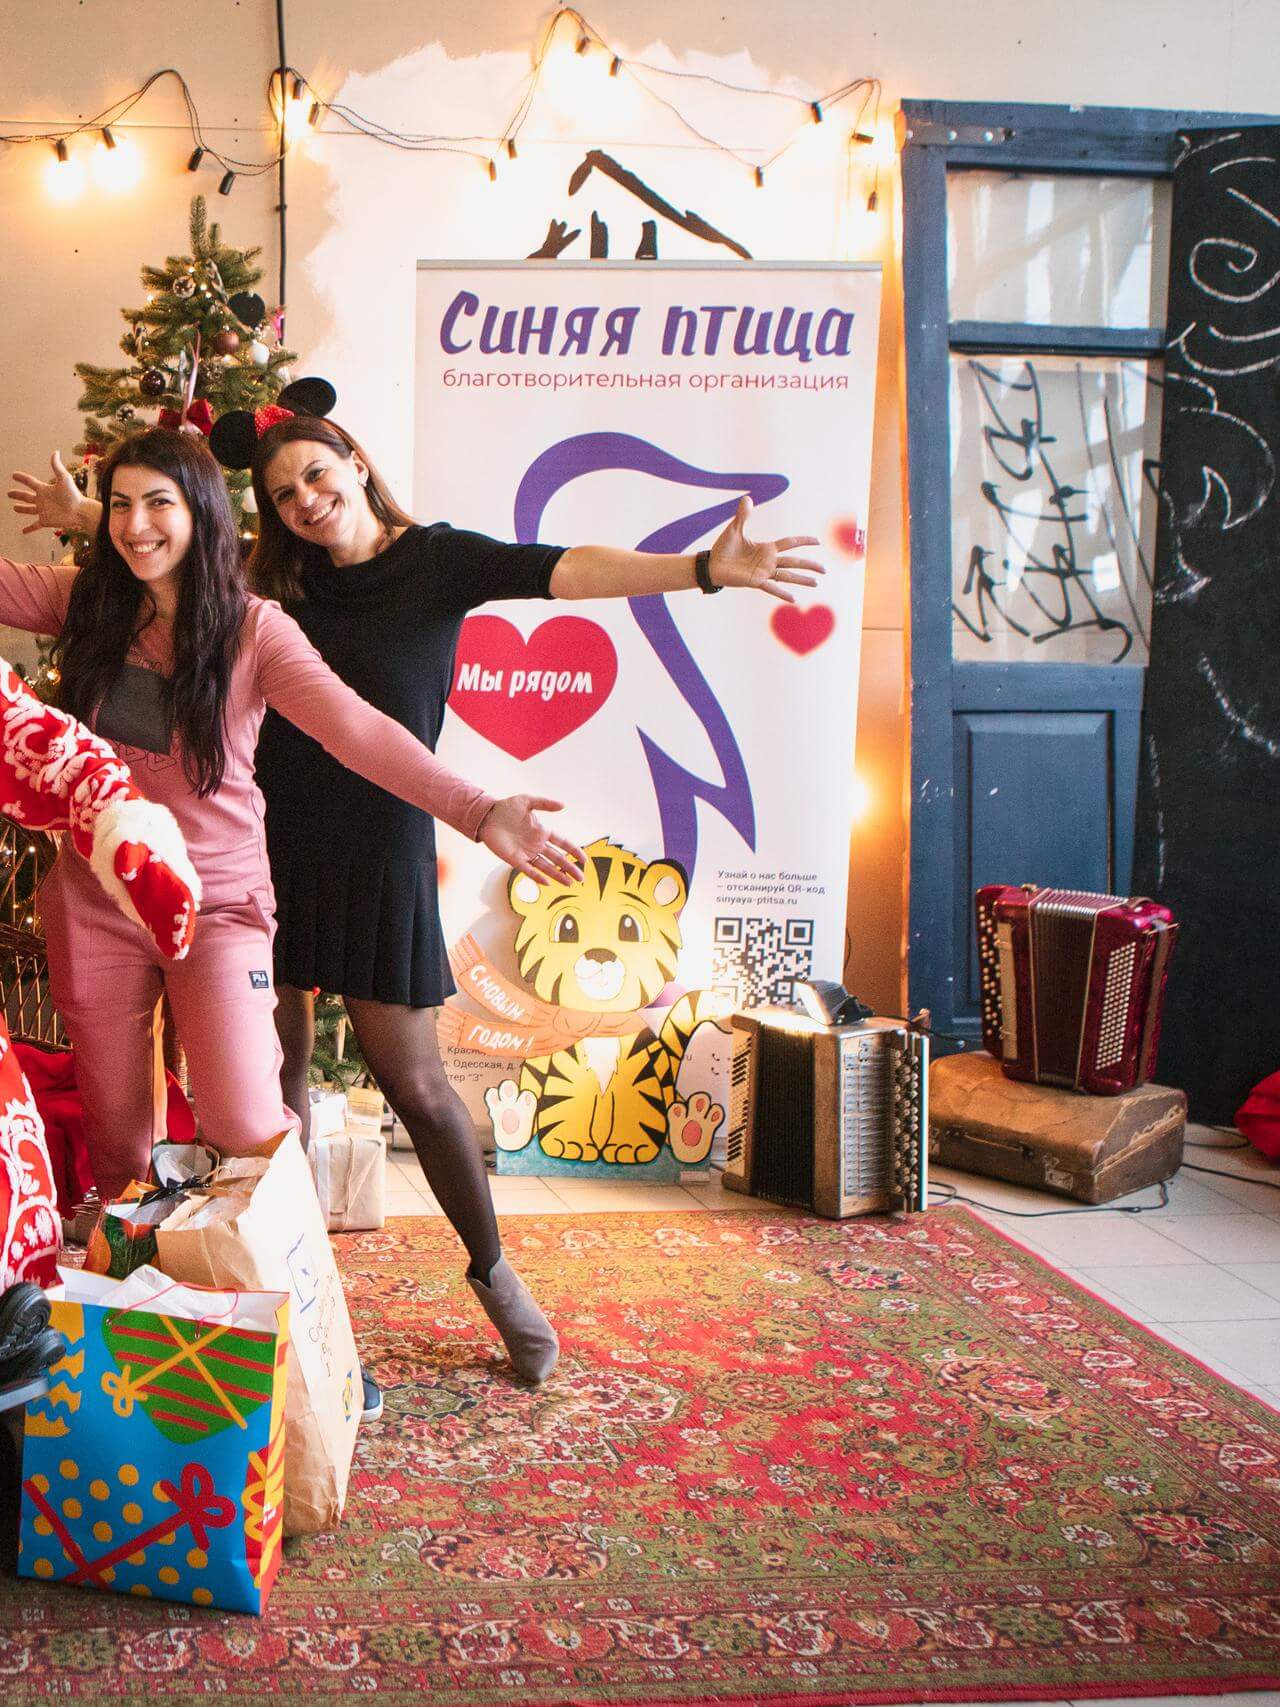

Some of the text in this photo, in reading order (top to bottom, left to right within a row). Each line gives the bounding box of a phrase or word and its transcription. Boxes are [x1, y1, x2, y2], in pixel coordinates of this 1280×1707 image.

[440, 290, 855, 362] Синяя птица
[442, 368, 849, 393] благотворительная организация
[457, 663, 593, 701] Мы рядом
[717, 870, 818, 882] Узнай о нас больше
[716, 894, 798, 906] sinyaya-ptitsa.ru
[726, 884, 785, 894] отсканируй
[787, 884, 826, 895] QR-код
[470, 964, 524, 1020] С НОВЫМ
